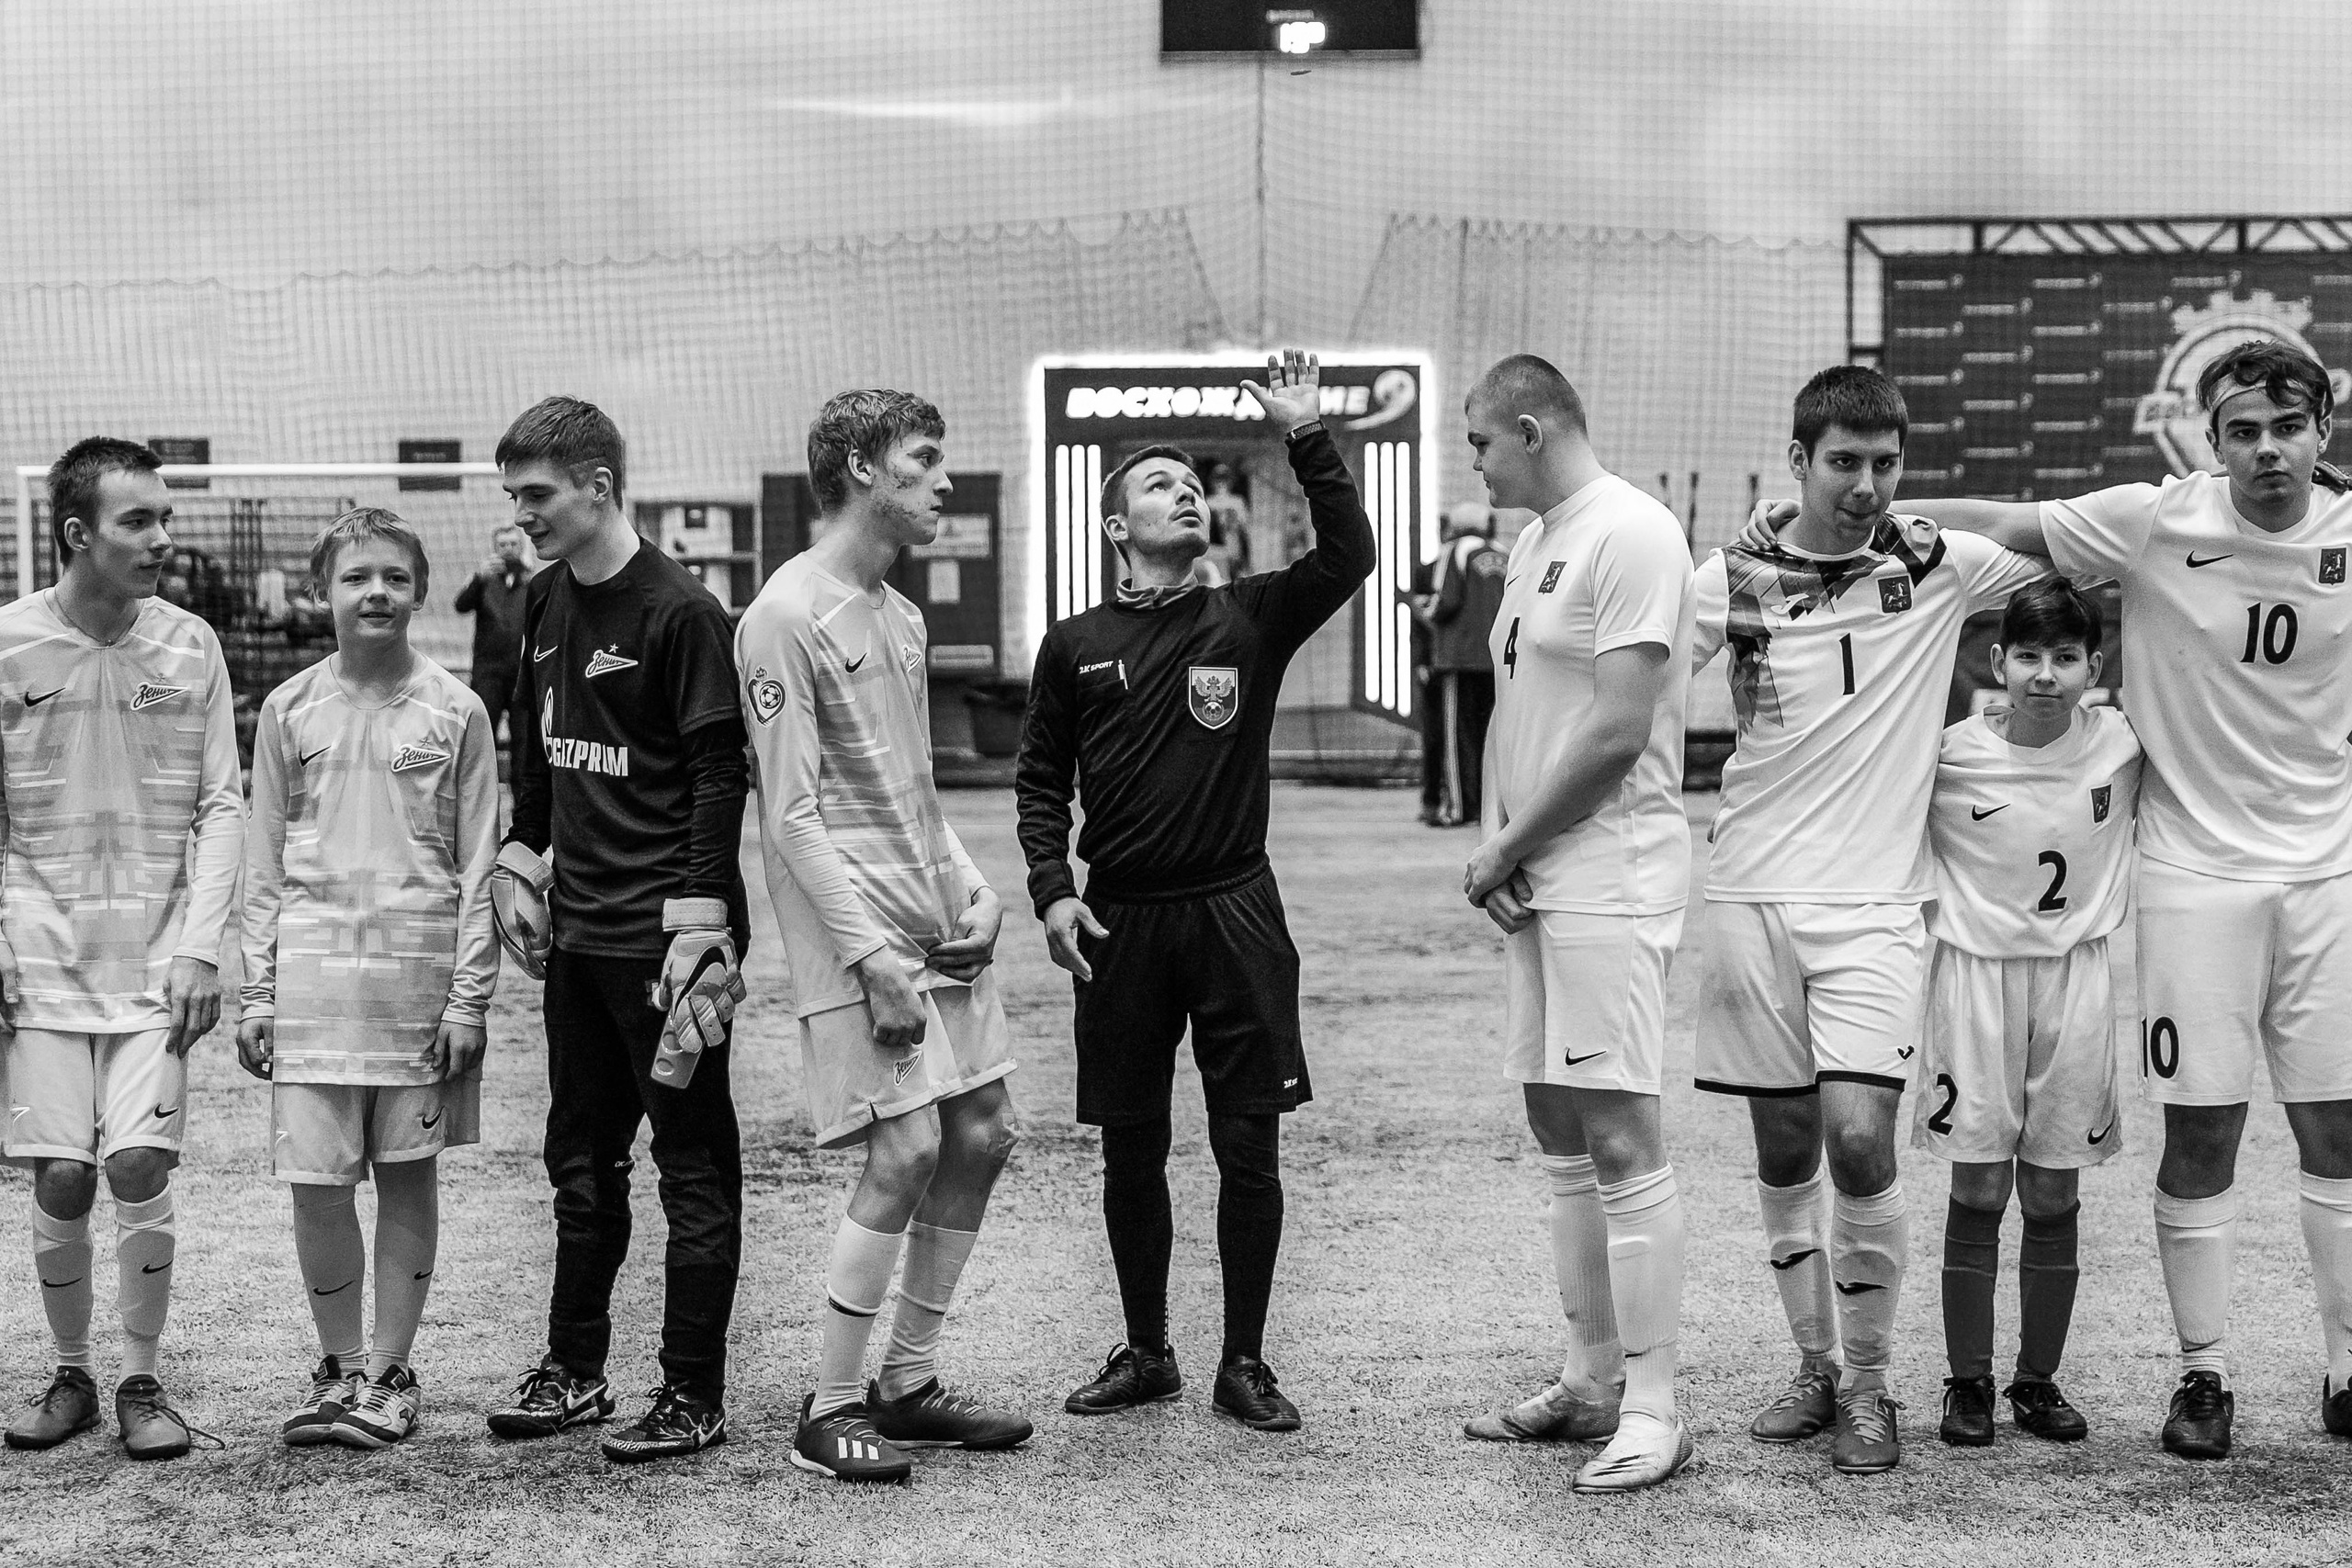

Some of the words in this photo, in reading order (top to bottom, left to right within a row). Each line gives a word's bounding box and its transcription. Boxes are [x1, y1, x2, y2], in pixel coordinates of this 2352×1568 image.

[1066, 385, 1371, 421] ВОСХОЖДИЕ
[1503, 616, 1521, 680] 4
[1838, 632, 1856, 696] 1
[2240, 602, 2298, 664] 10
[1091, 660, 1114, 671] SPORT
[2038, 850, 2068, 912] 2
[2141, 1015, 2180, 1079] 10
[1928, 1073, 1959, 1137] 2
